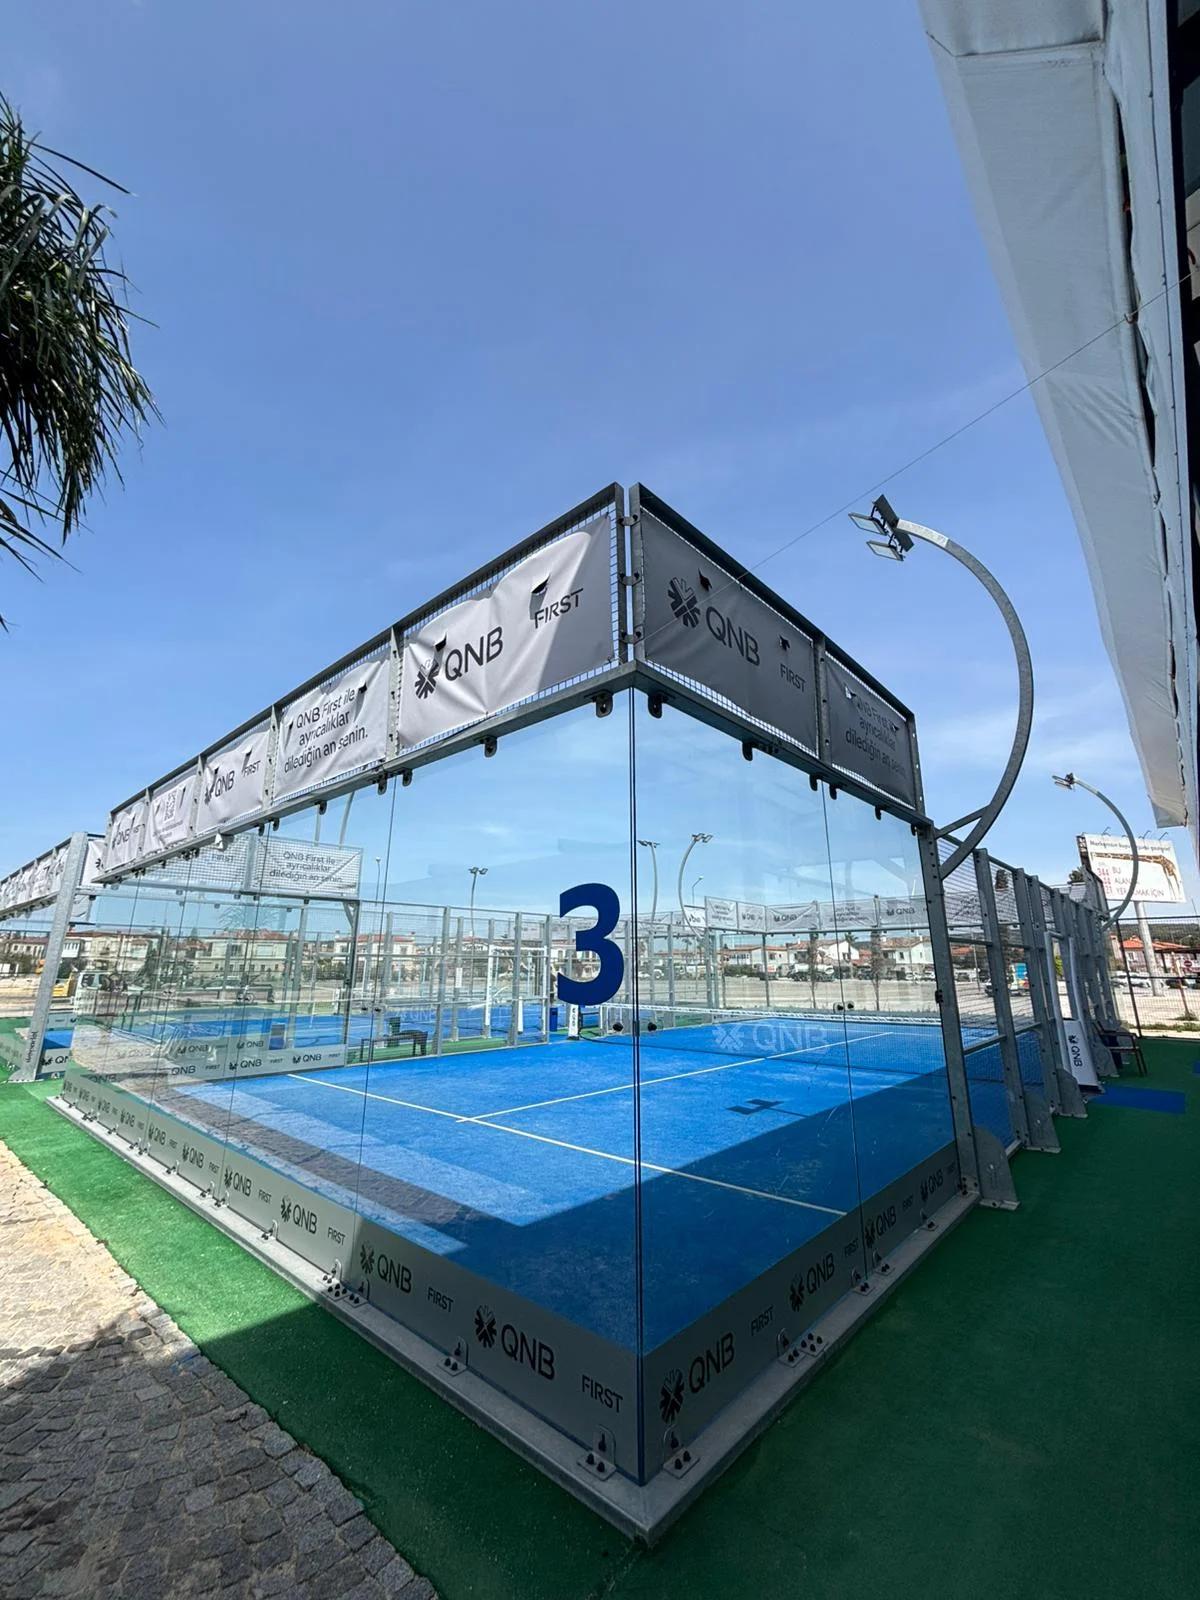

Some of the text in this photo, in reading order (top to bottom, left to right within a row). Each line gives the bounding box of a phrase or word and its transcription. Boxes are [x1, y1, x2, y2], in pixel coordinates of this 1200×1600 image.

[445, 588, 584, 681] QNB FIRST
[705, 606, 806, 693] QNB FIRST
[296, 688, 355, 729] QNB First ile
[323, 740, 337, 756] an
[214, 770, 235, 797] QNB
[283, 851, 304, 861] QNB
[896, 907, 915, 915] QNB
[557, 883, 625, 1006] 3
[246, 1040, 264, 1048] QNB
[753, 1023, 828, 1053] QNB
[171, 1065, 196, 1076] QNB
[240, 1058, 262, 1068] QNB
[303, 1053, 322, 1063] QNB
[1071, 1045, 1083, 1067] QNB
[154, 1127, 167, 1146] QNB
[189, 1148, 205, 1169] QNB
[233, 1173, 252, 1197] QNB
[259, 1189, 272, 1202] FIRST
[292, 1203, 317, 1235] QNB
[328, 1226, 346, 1247] FIRST
[377, 1253, 412, 1294] QNB
[427, 1287, 454, 1313] FIRST
[501, 1323, 555, 1381] QNB
[582, 1374, 624, 1413] FIRST
[688, 1332, 735, 1394] QNB
[750, 1306, 774, 1337] FIRST
[805, 1252, 836, 1296] QNB
[875, 1205, 897, 1238] QNB
[928, 1170, 943, 1195] QNB
